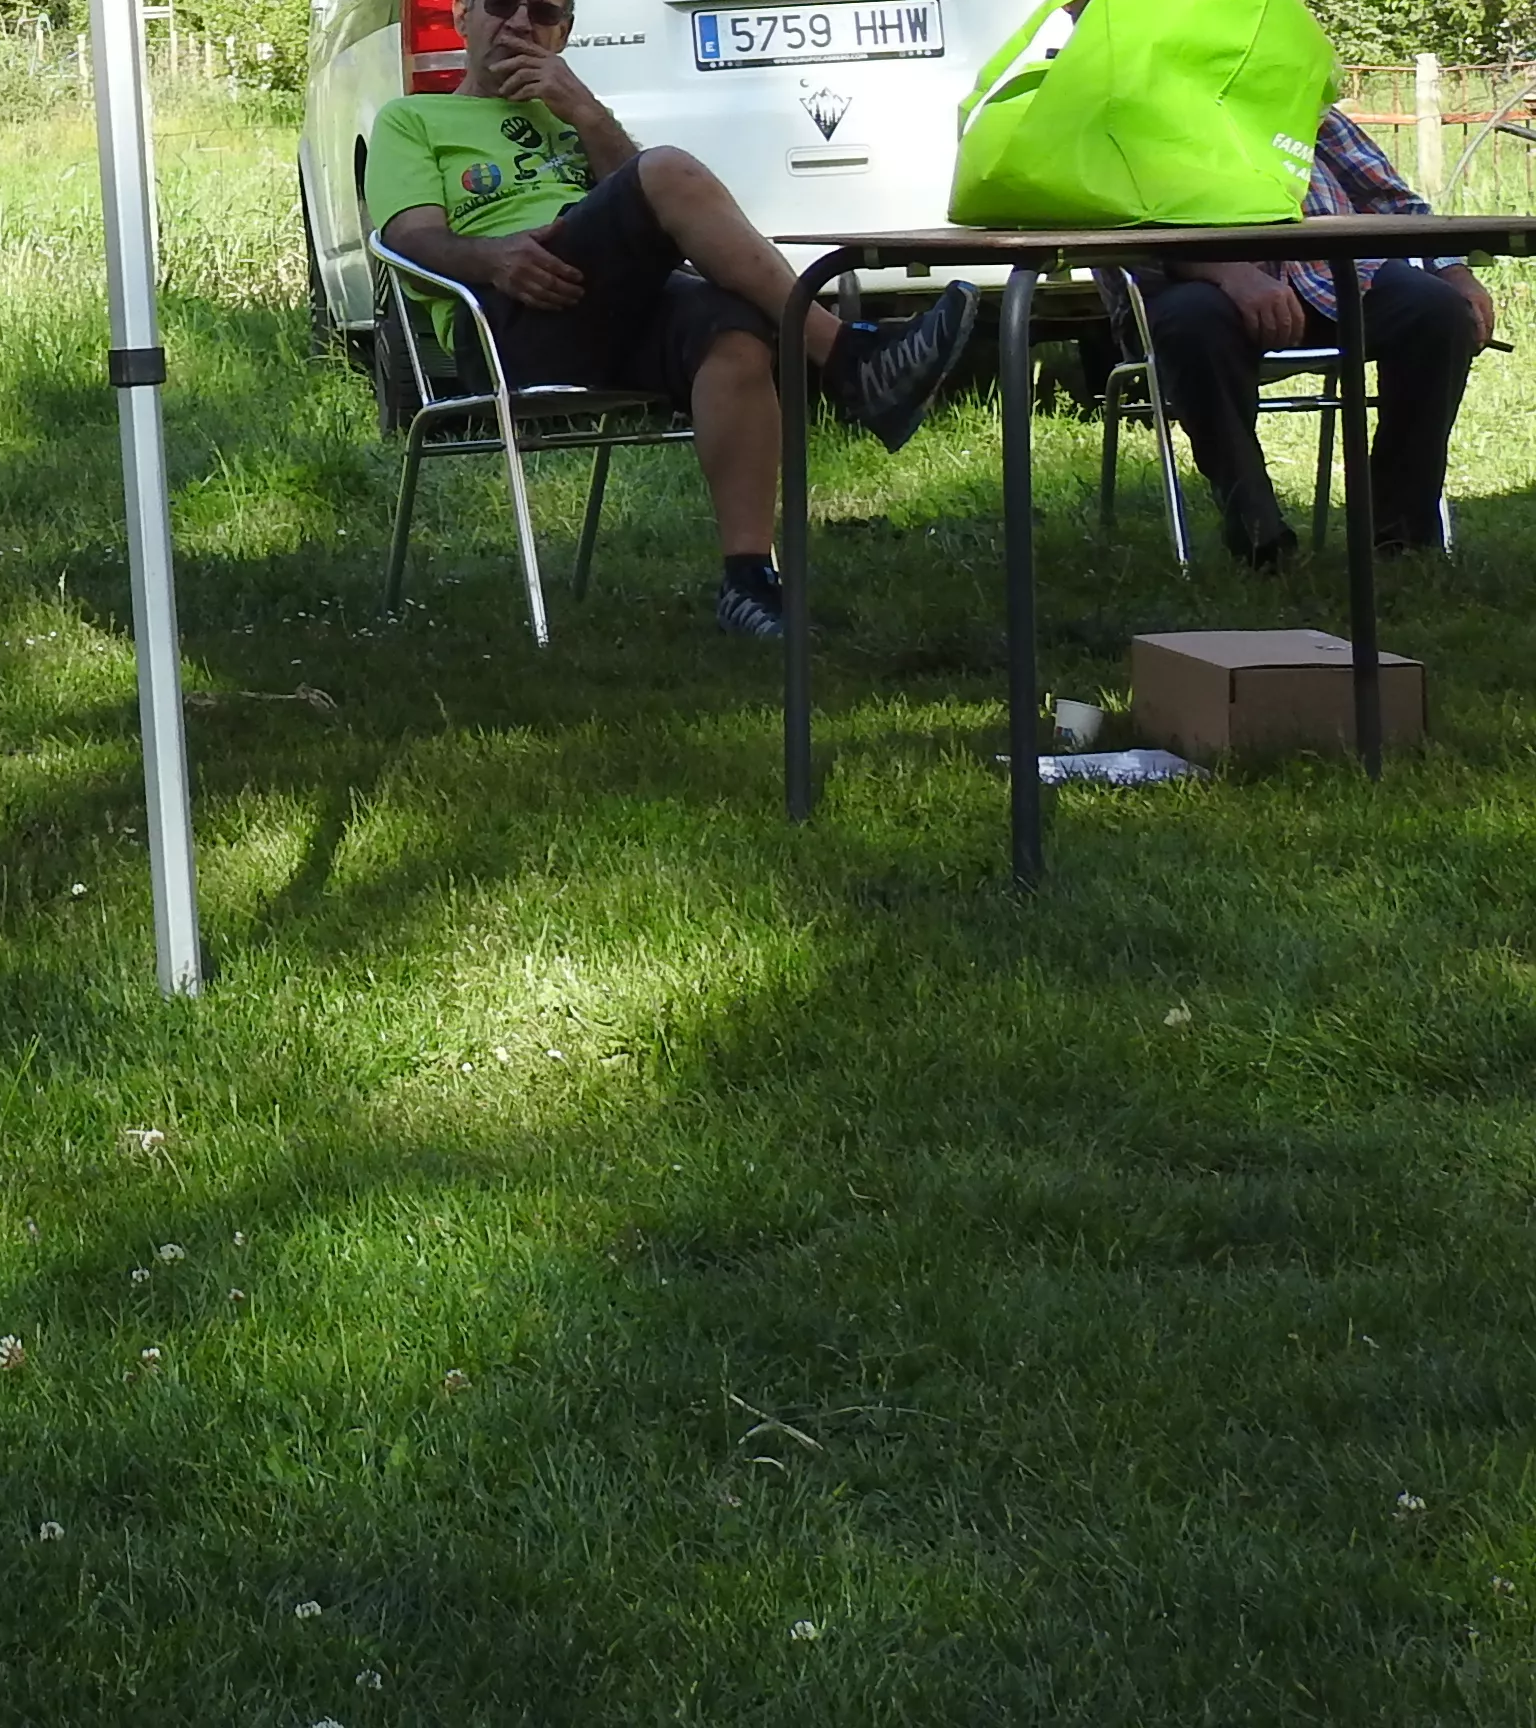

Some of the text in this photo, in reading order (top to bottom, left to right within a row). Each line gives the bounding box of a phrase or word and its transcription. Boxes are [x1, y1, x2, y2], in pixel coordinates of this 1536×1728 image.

[566, 31, 646, 47] AVELLE
[730, 6, 928, 53] 5759 HHW
[704, 41, 717, 53] E
[1272, 132, 1315, 164] FARM
